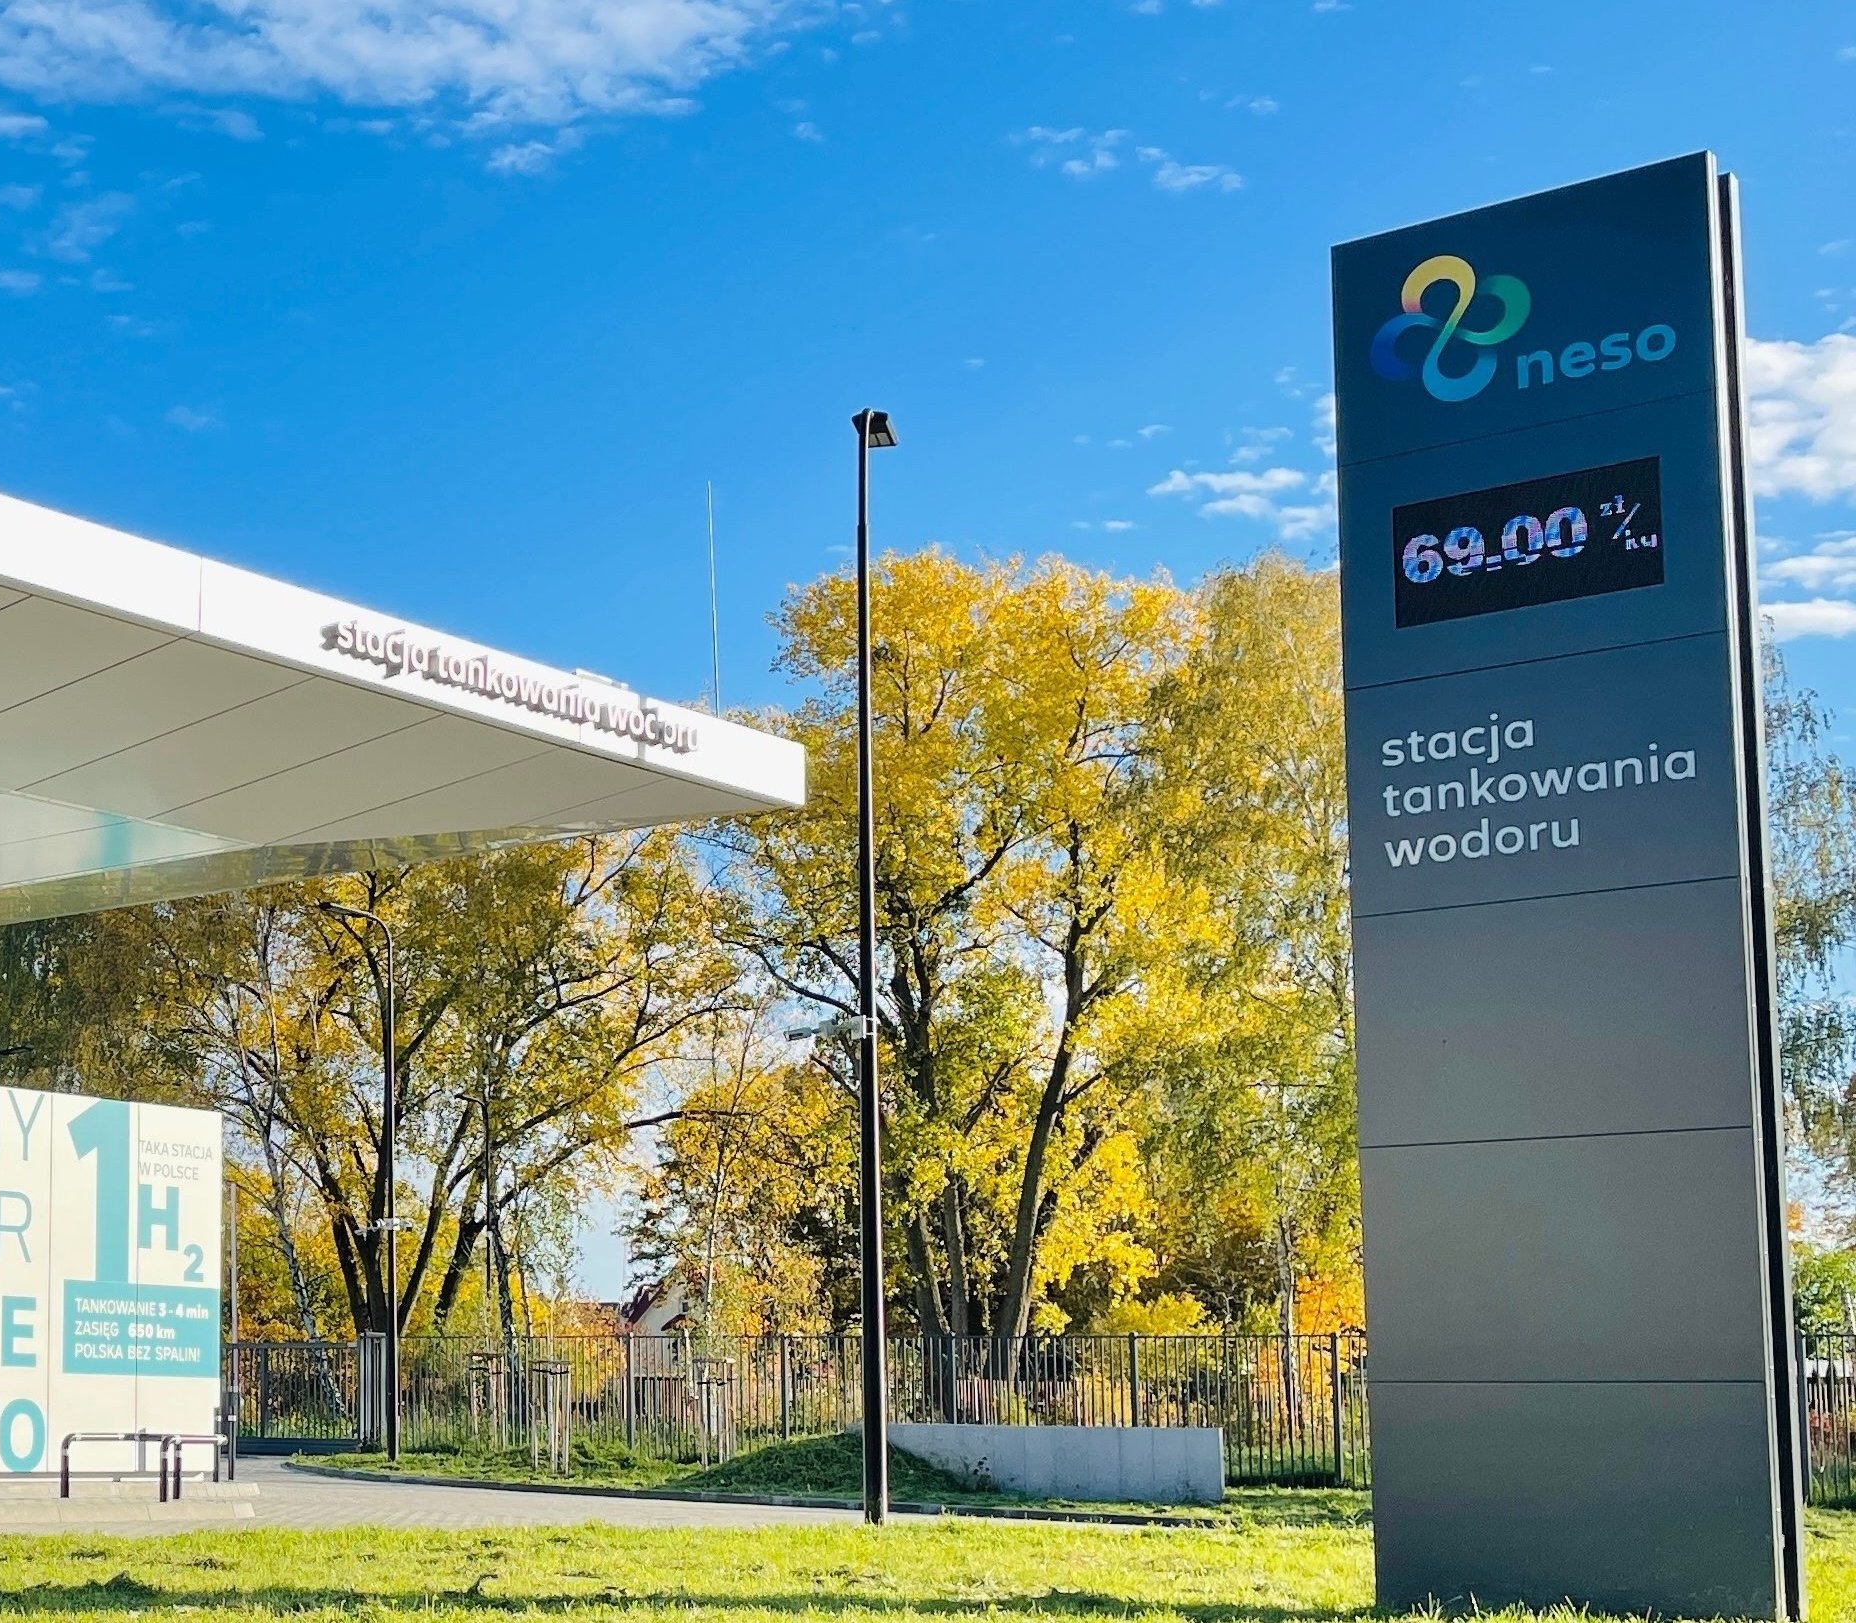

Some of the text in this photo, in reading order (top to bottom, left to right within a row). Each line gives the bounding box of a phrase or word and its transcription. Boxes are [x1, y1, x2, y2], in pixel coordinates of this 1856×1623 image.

[1517, 325, 1676, 389] neso
[1402, 506, 1588, 583] 69.00
[335, 618, 431, 676] stacja
[437, 646, 601, 723] tankowania
[1381, 712, 1534, 766] stacja
[1382, 742, 1697, 817] tankowania
[1384, 817, 1580, 868] wodoru
[137, 1161, 199, 1181] W POLSCE
[138, 1139, 213, 1161] TAKA STACJA
[74, 1297, 156, 1317] TANKOWANIE
[186, 1303, 208, 1319] min
[74, 1320, 175, 1340] ZASIĘG 650 km
[74, 1343, 201, 1363] POLSKA BEZ SPALIN!
